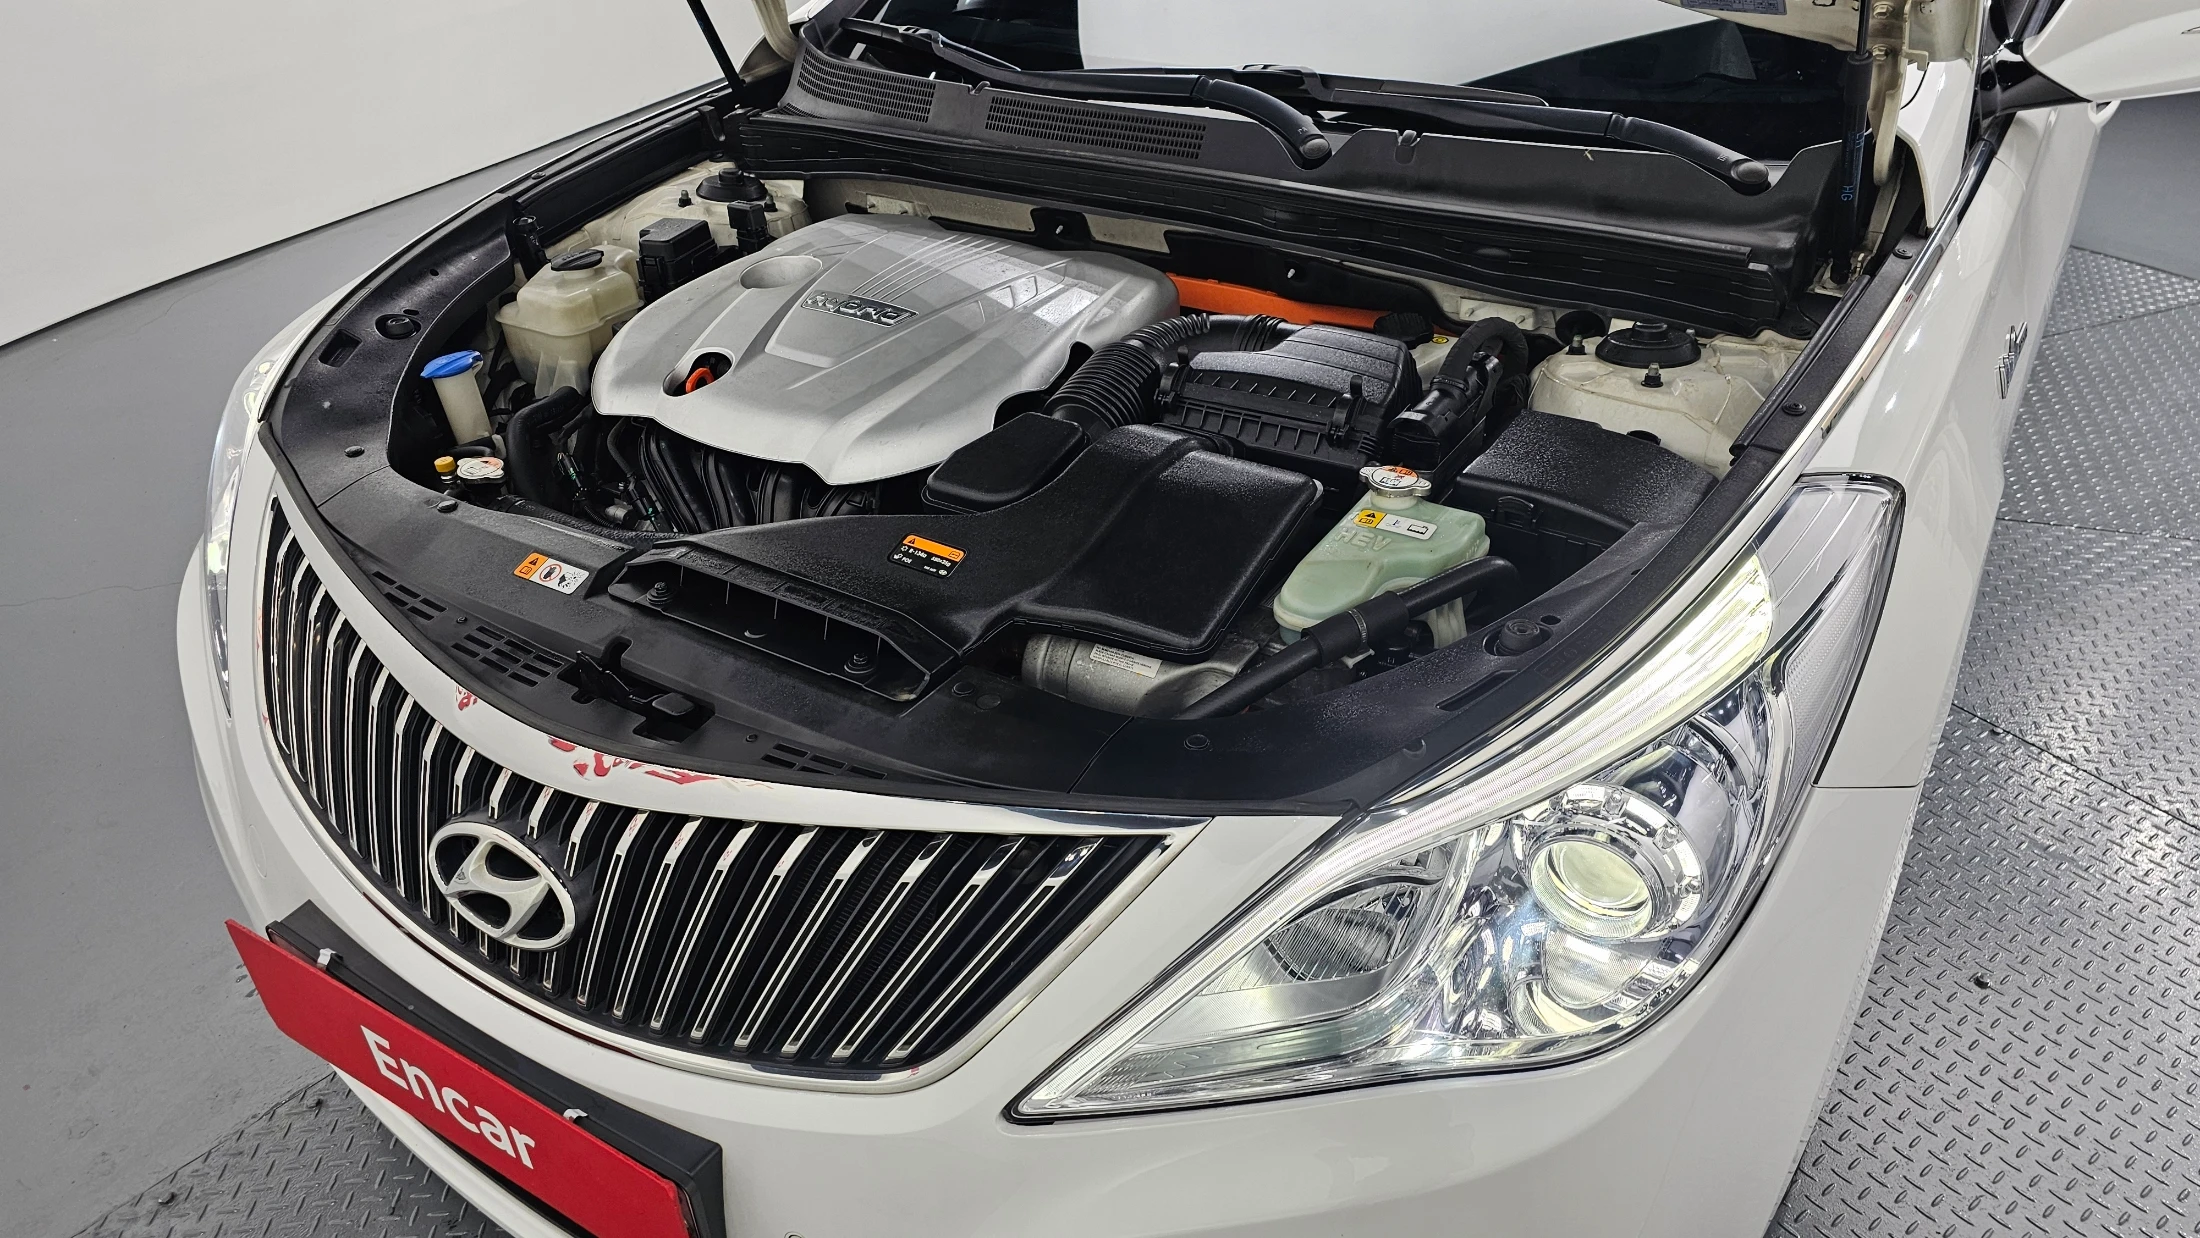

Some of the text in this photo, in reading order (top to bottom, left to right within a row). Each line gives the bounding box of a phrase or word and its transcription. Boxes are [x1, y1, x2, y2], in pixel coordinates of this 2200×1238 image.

[1841, 185, 1855, 201] HG
[1334, 529, 1392, 552] HEV
[360, 1025, 536, 1170] Encar
